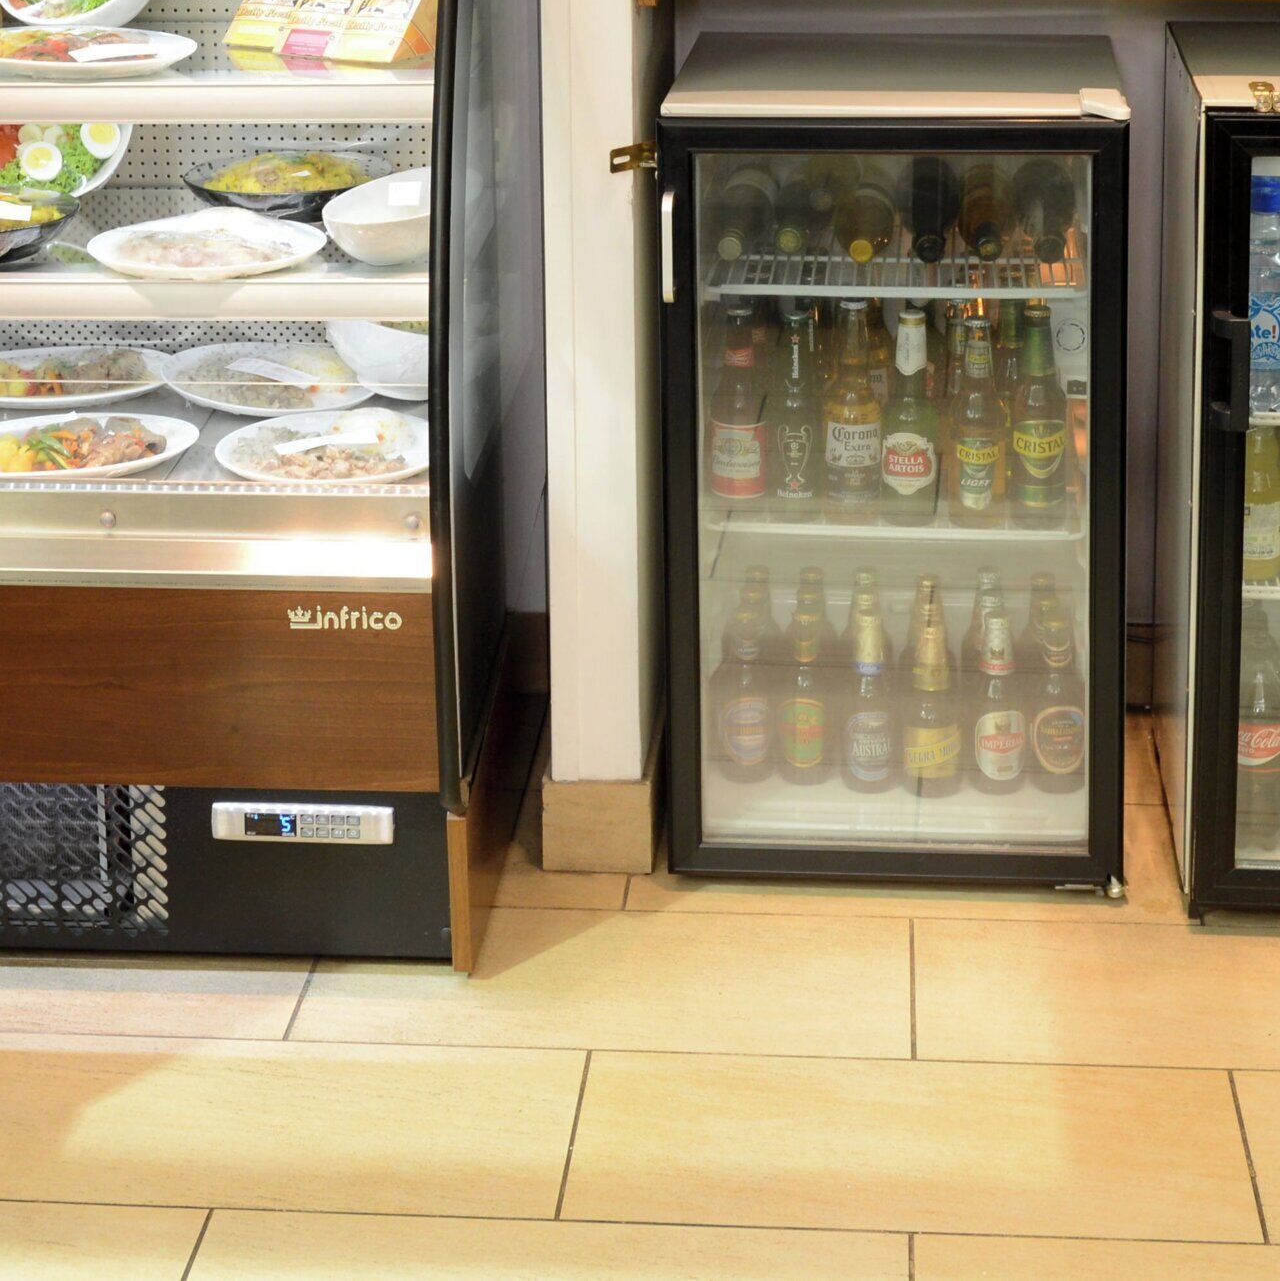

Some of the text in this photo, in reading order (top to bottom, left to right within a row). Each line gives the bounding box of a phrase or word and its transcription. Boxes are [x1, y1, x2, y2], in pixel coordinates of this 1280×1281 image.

[832, 425, 879, 441] Corona
[1016, 436, 1064, 454] CRISTAL
[888, 454, 924, 465] STELLA
[959, 448, 998, 461] CRISTAL
[888, 463, 925, 474] ARTOIS
[960, 477, 992, 487] LIGHT
[777, 488, 813, 499] Heineken
[315, 605, 404, 630] infrico
